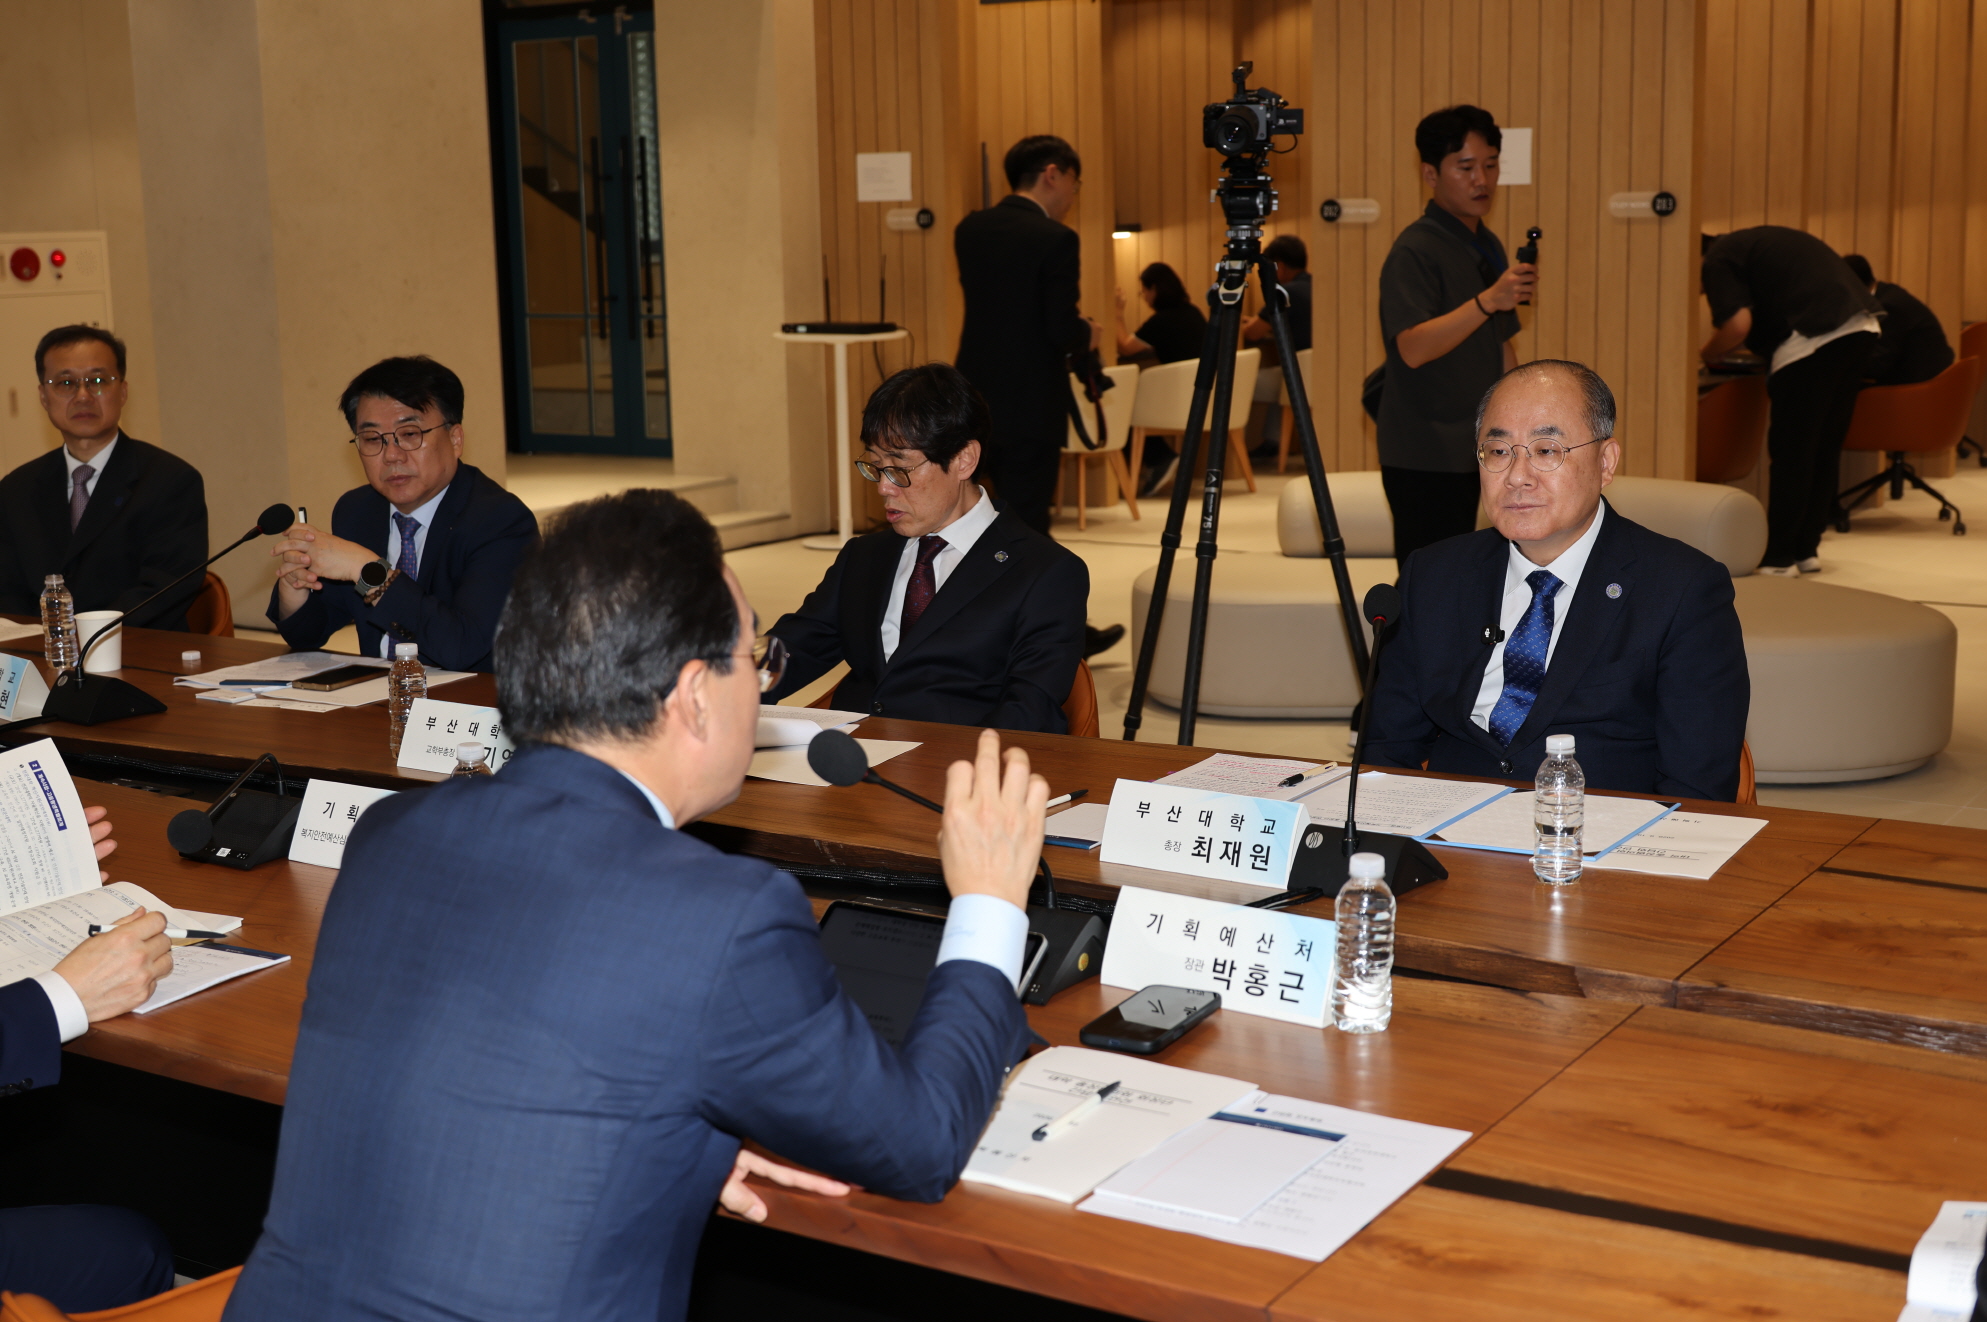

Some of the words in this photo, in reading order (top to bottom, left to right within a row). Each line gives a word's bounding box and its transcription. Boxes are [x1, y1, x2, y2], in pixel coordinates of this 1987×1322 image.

[1135, 801, 1277, 836] 부산대학교
[1163, 839, 1182, 853] 총장
[1191, 836, 1272, 872] 최재원
[1146, 913, 1314, 962] 기획예산처
[1184, 957, 1205, 973] 장관
[1212, 957, 1305, 1003] 박홍근
